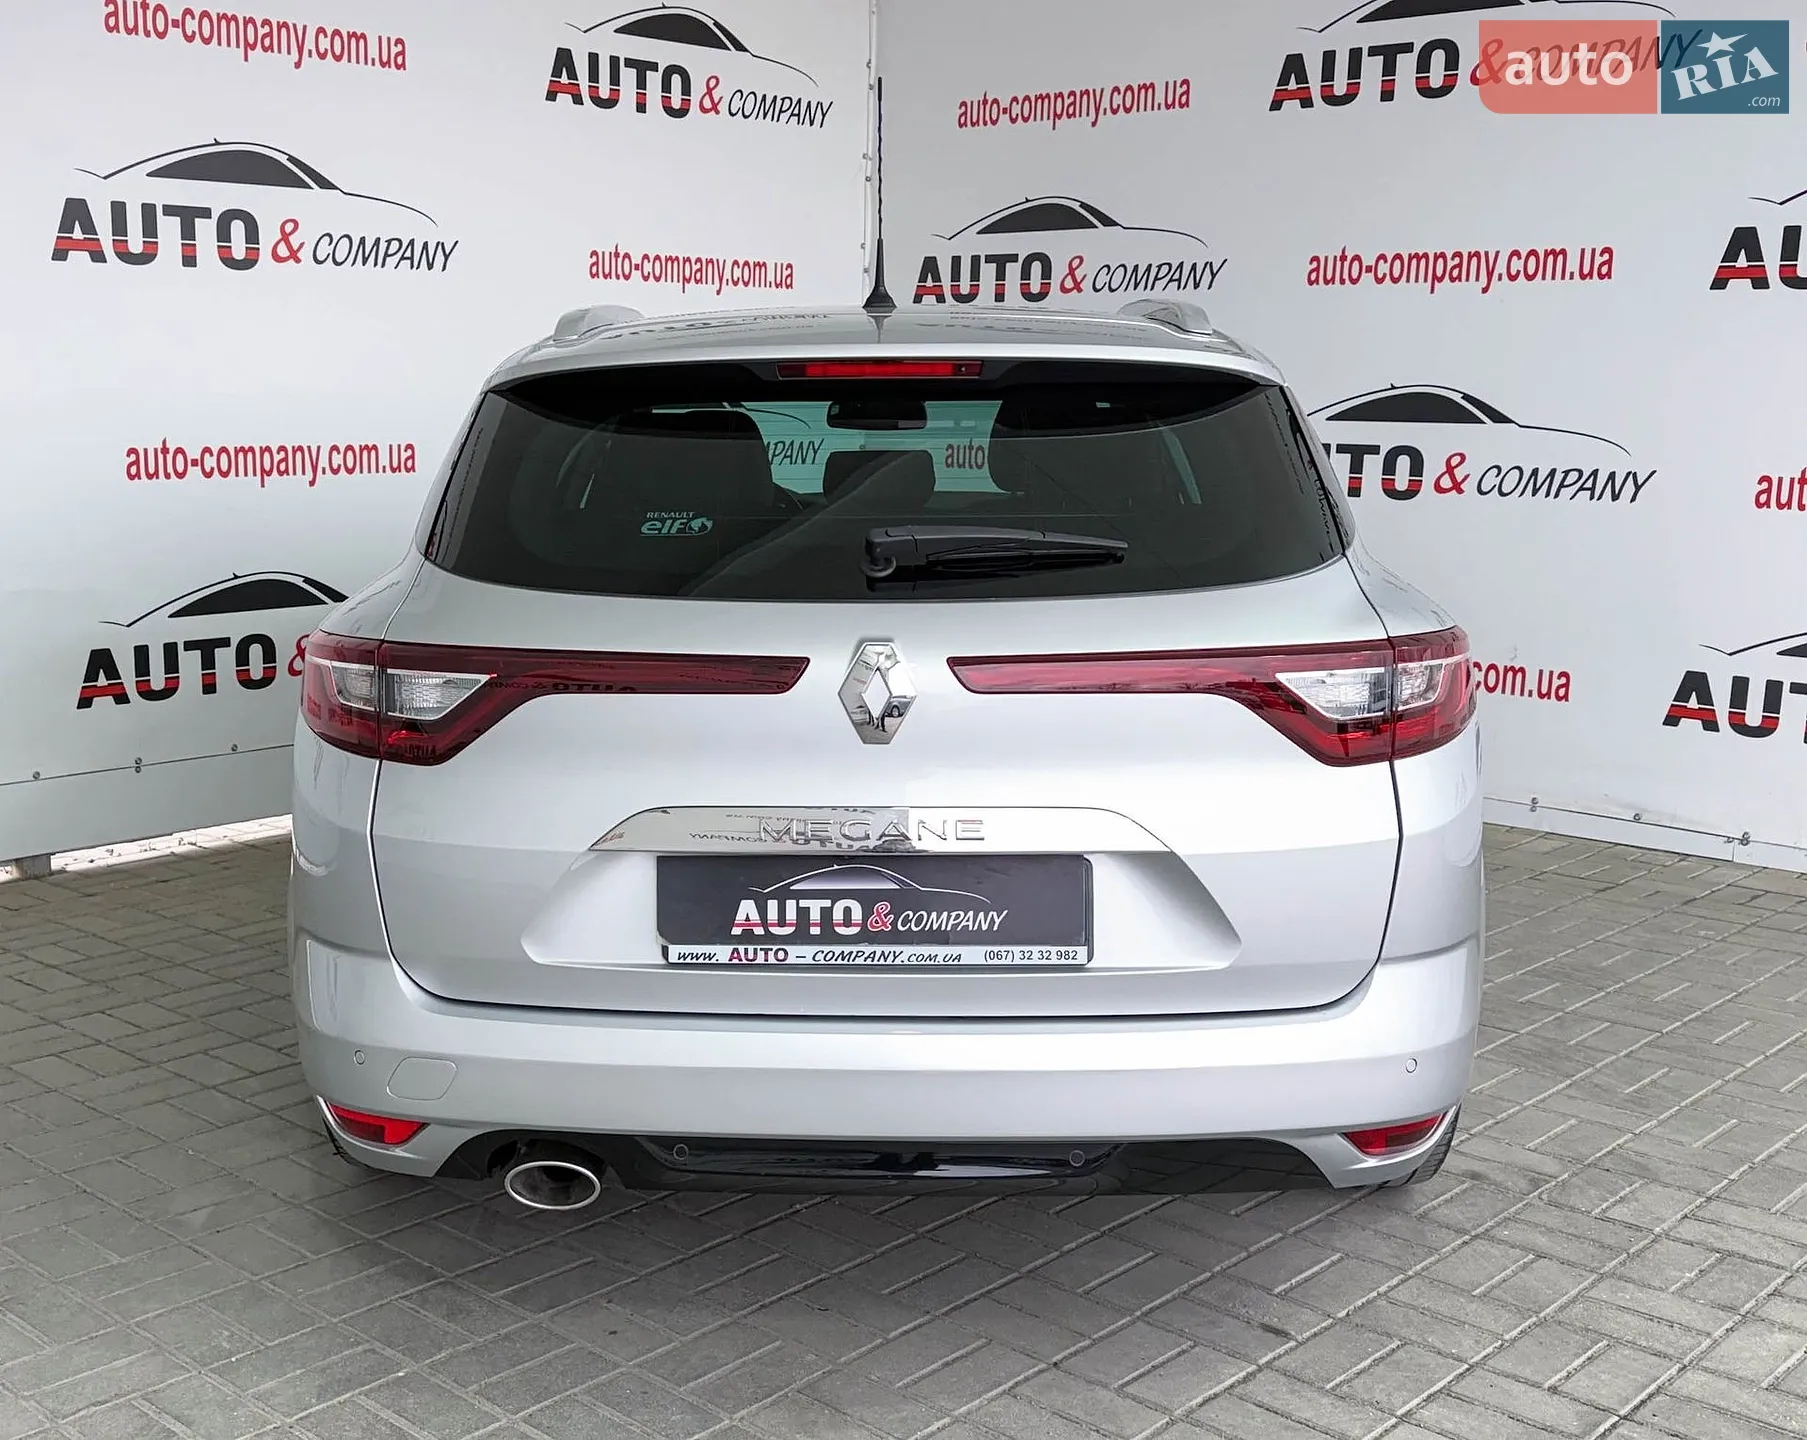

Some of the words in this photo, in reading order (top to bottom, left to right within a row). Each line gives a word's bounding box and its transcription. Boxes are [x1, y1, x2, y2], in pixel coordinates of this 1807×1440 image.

[104, 0, 406, 70] auto-company.com.ua
[545, 47, 692, 118] AUTO
[698, 75, 723, 116] &
[727, 88, 833, 129] COMPANY
[1269, 38, 1460, 112] AUTO
[957, 78, 1190, 130] auto-company.com.ua
[52, 198, 260, 271] AUTO
[271, 218, 305, 265] &
[312, 232, 459, 272] COMPANY
[588, 244, 794, 294] auto-company.com.ua
[912, 252, 1052, 304] AUTO
[1059, 255, 1087, 293] &
[1091, 258, 1228, 293] COMPANY
[1306, 245, 1614, 294] auto-company.com.ua
[126, 437, 416, 488] auto-company.com.ua
[1321, 443, 1424, 500] TO
[1433, 452, 1471, 495] &
[1477, 465, 1657, 504] COMPANY
[646, 511, 695, 519] RENAULT
[76, 633, 277, 709] AUTO
[758, 818, 985, 842] MEGANE
[731, 899, 863, 936] AUTO
[867, 901, 895, 932] &
[896, 909, 1008, 932] COMPANY
[728, 947, 789, 962] AUTO
[984, 949, 1015, 963] (067)
[1019, 949, 1034, 961] 32
[1037, 949, 1052, 961] 32
[1056, 949, 1078, 961] 982
